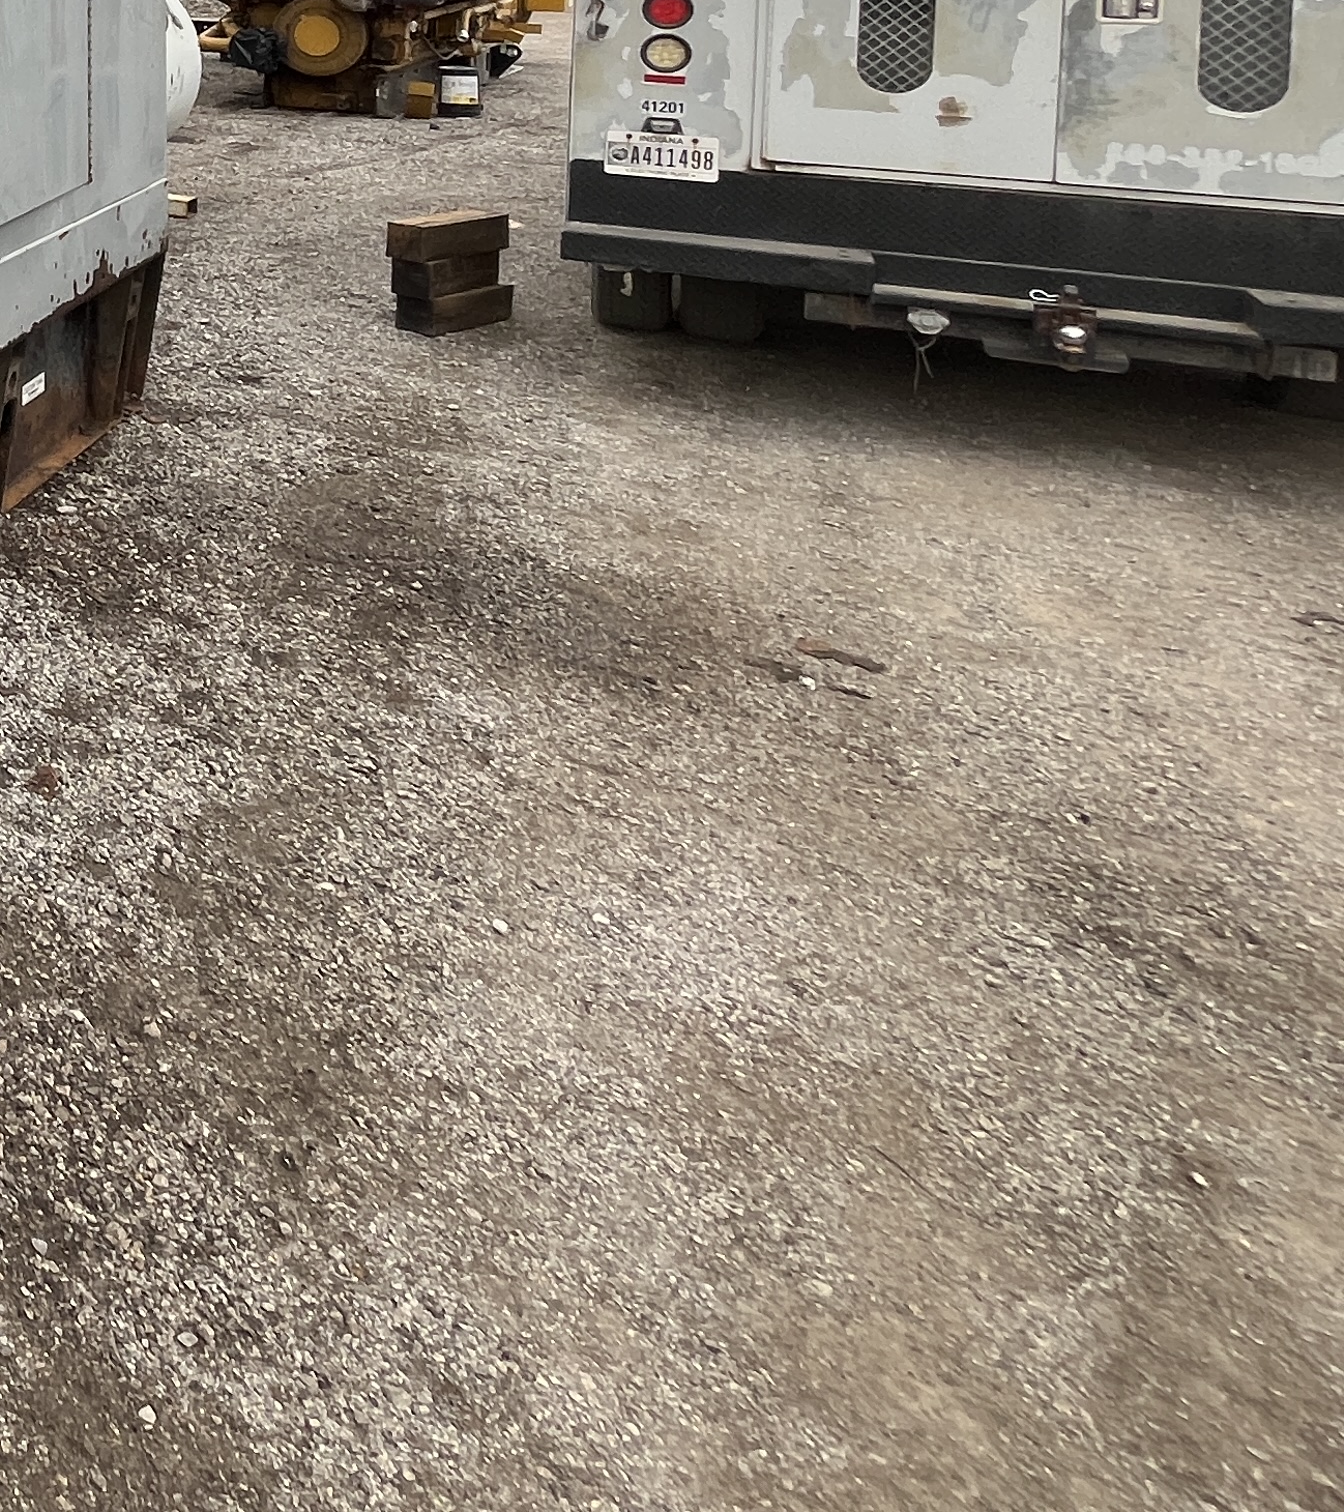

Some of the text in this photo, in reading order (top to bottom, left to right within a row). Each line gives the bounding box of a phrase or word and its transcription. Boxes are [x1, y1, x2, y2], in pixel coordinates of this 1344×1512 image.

[641, 99, 684, 114] 41201
[639, 135, 684, 145] INDIANA
[630, 145, 714, 170] A411498
